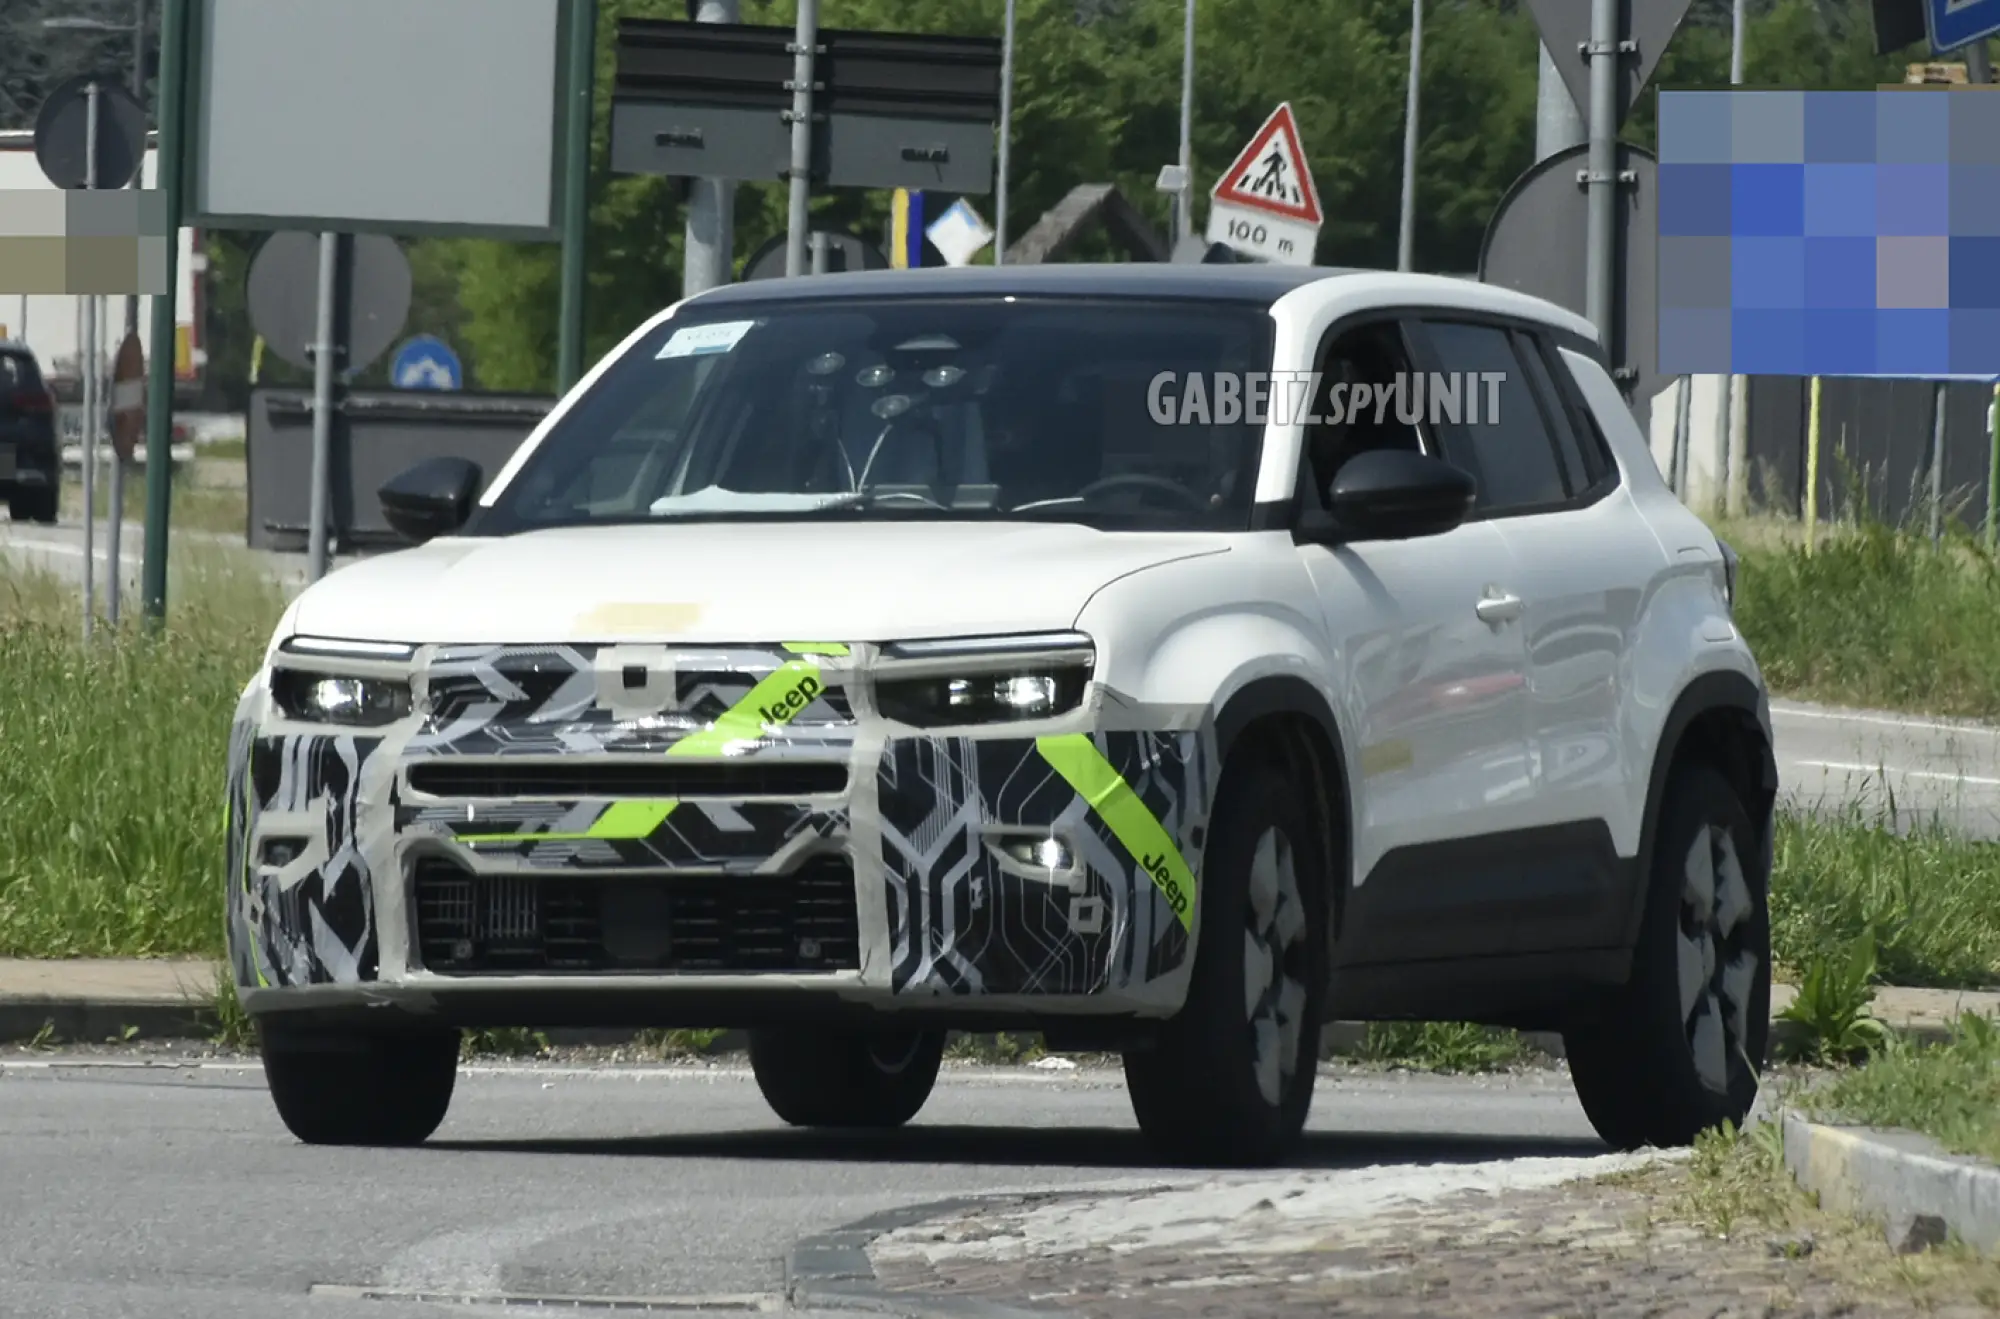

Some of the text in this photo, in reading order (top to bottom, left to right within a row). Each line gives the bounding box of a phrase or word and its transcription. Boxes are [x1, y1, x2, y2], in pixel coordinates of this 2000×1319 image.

[1229, 218, 1294, 256] 100 m
[1142, 853, 1187, 914] Jeep
